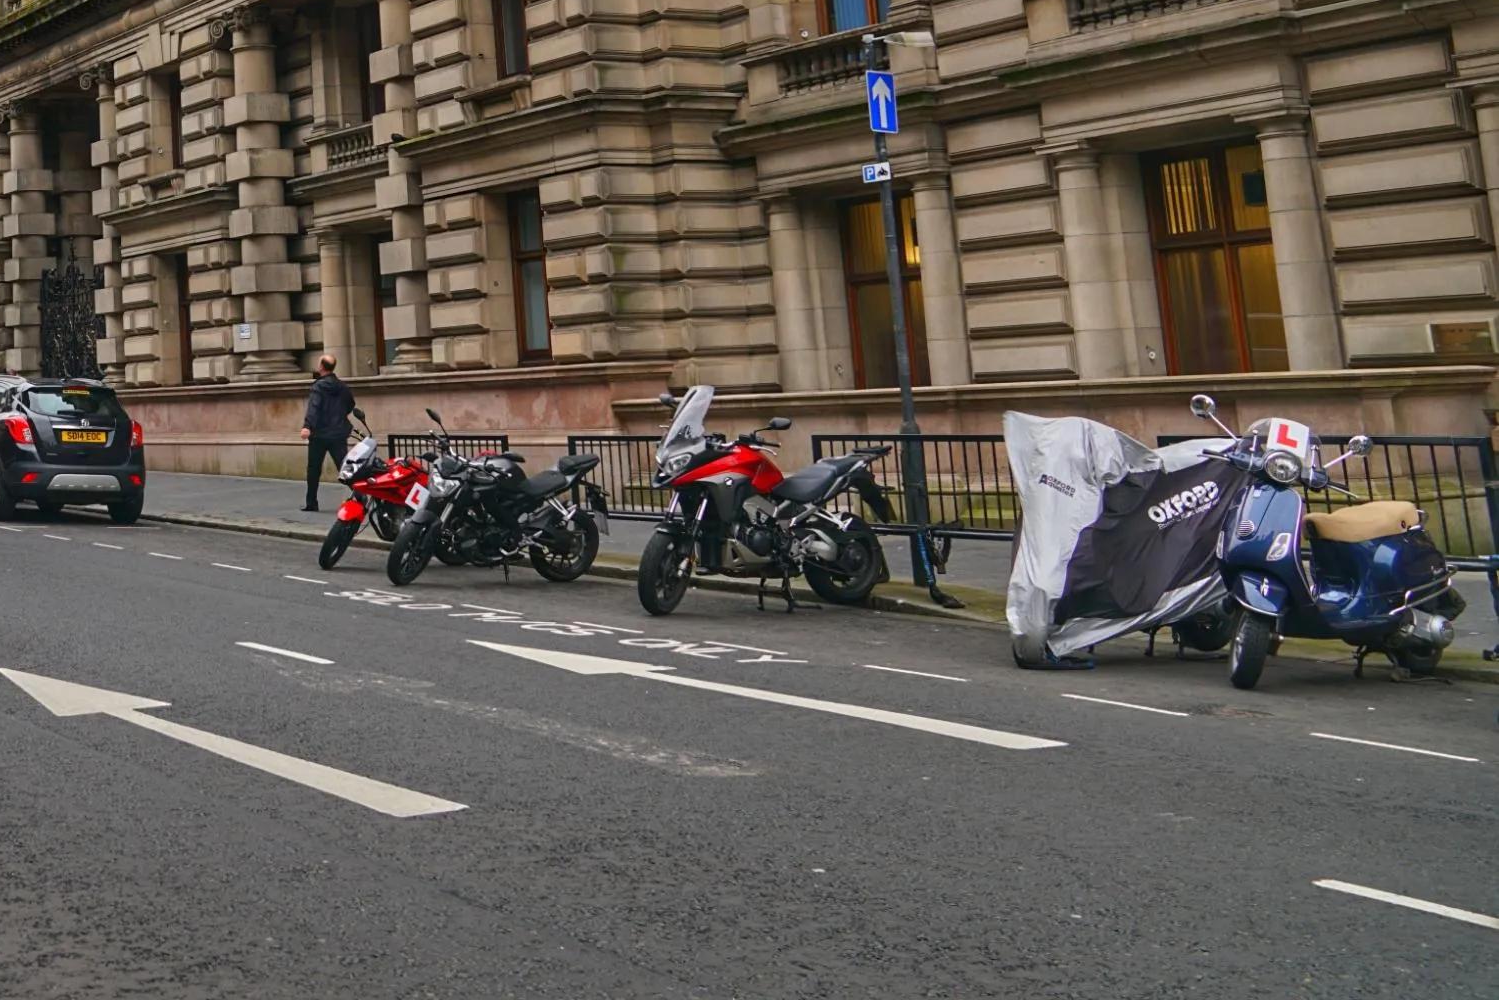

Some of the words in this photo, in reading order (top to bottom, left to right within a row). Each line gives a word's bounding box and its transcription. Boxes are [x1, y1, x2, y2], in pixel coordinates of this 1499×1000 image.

[1277, 423, 1298, 449] L
[411, 489, 420, 505] L
[1147, 481, 1219, 523] OXFORD
